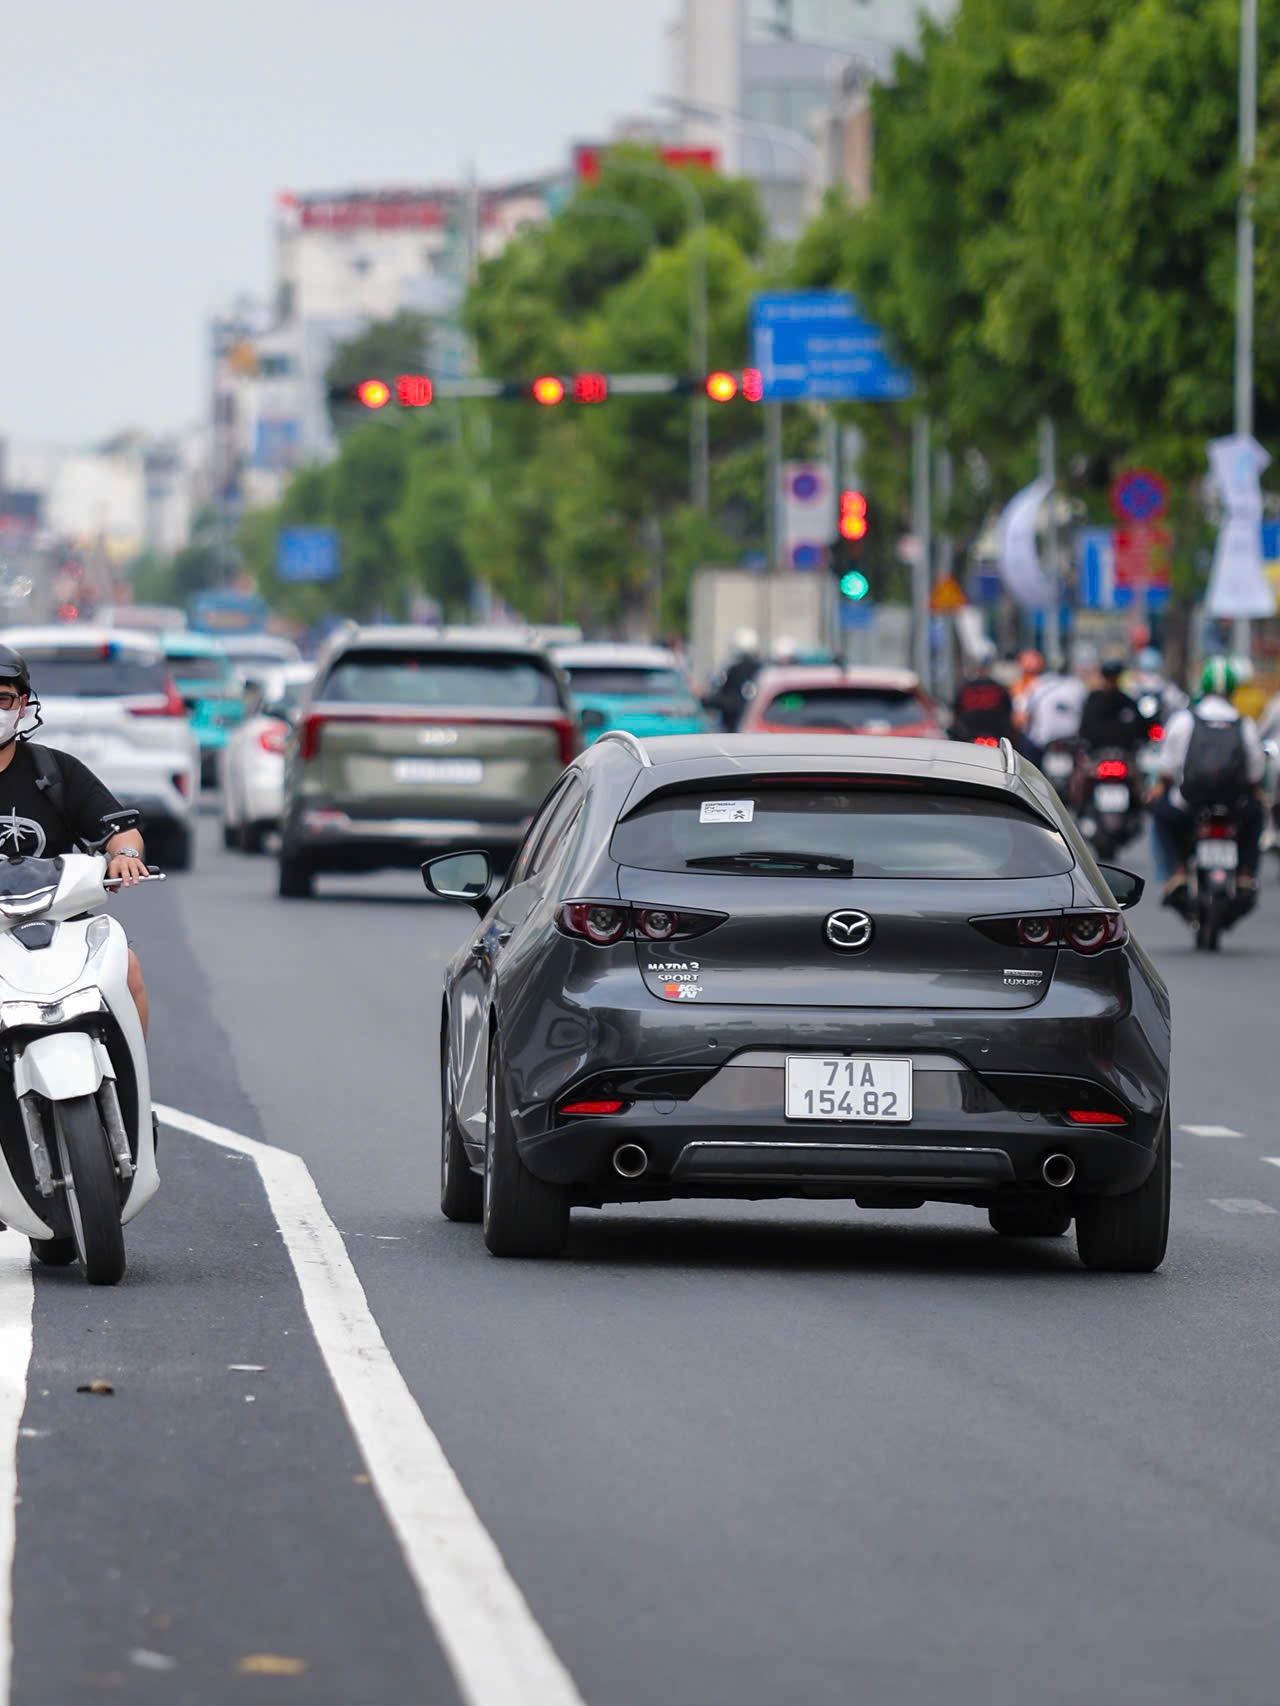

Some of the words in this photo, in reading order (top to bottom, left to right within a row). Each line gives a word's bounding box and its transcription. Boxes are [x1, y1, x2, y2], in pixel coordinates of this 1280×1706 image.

[690, 962, 700, 971] 3
[658, 974, 699, 982] SPORT
[823, 1061, 875, 1087] 71A
[804, 1089, 898, 1116] 154.82
